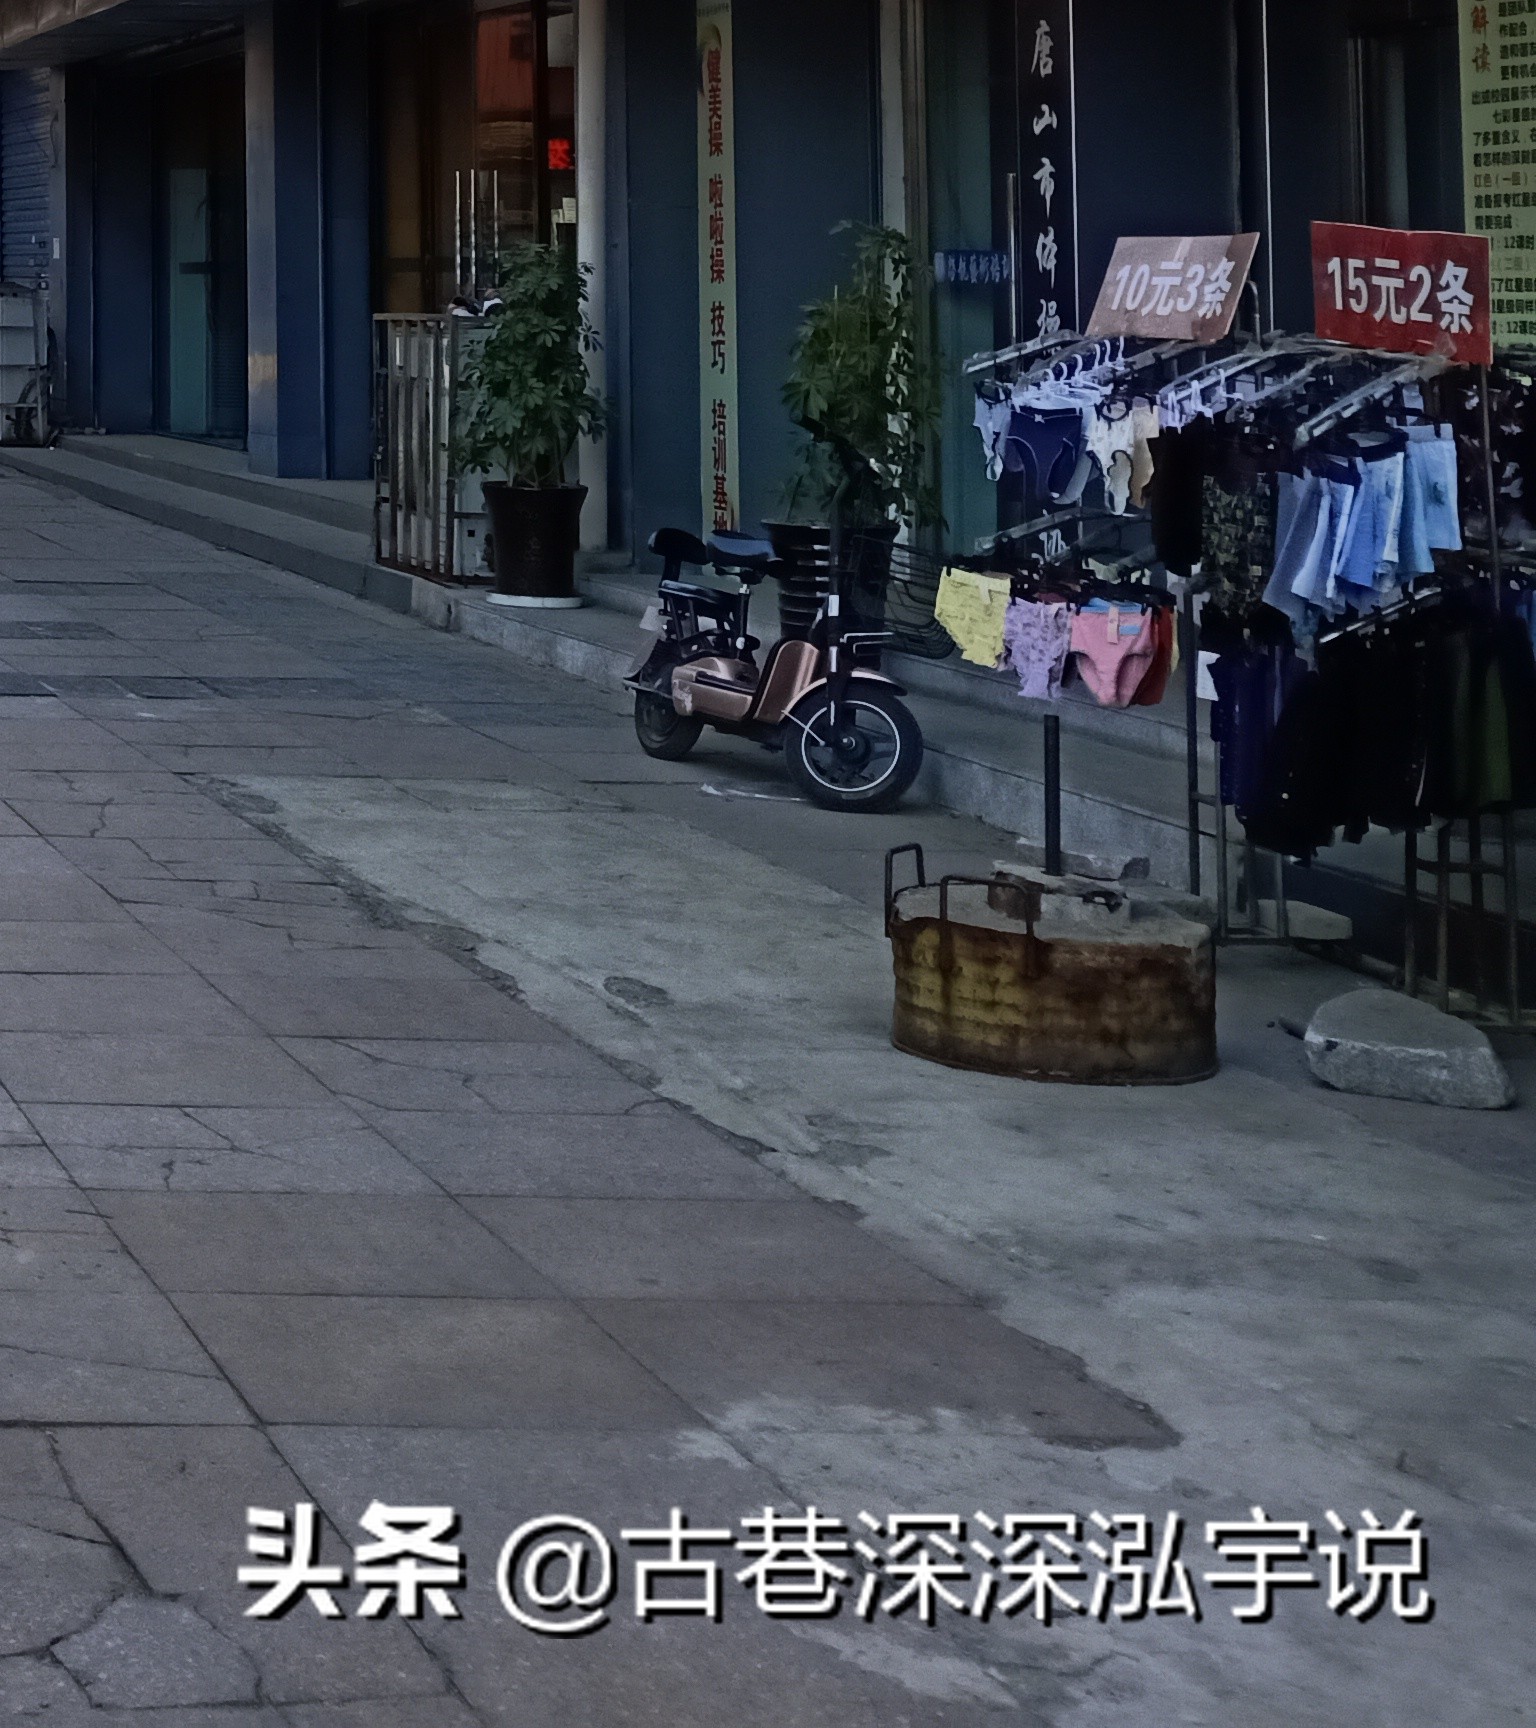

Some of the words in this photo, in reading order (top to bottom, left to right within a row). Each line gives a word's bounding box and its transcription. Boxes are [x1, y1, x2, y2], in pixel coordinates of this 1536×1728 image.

[707, 172, 726, 284] 啦啦操
[1109, 260, 1236, 319] 10元3条
[1327, 254, 1477, 336] 15元2条
[709, 300, 727, 377] 技巧
